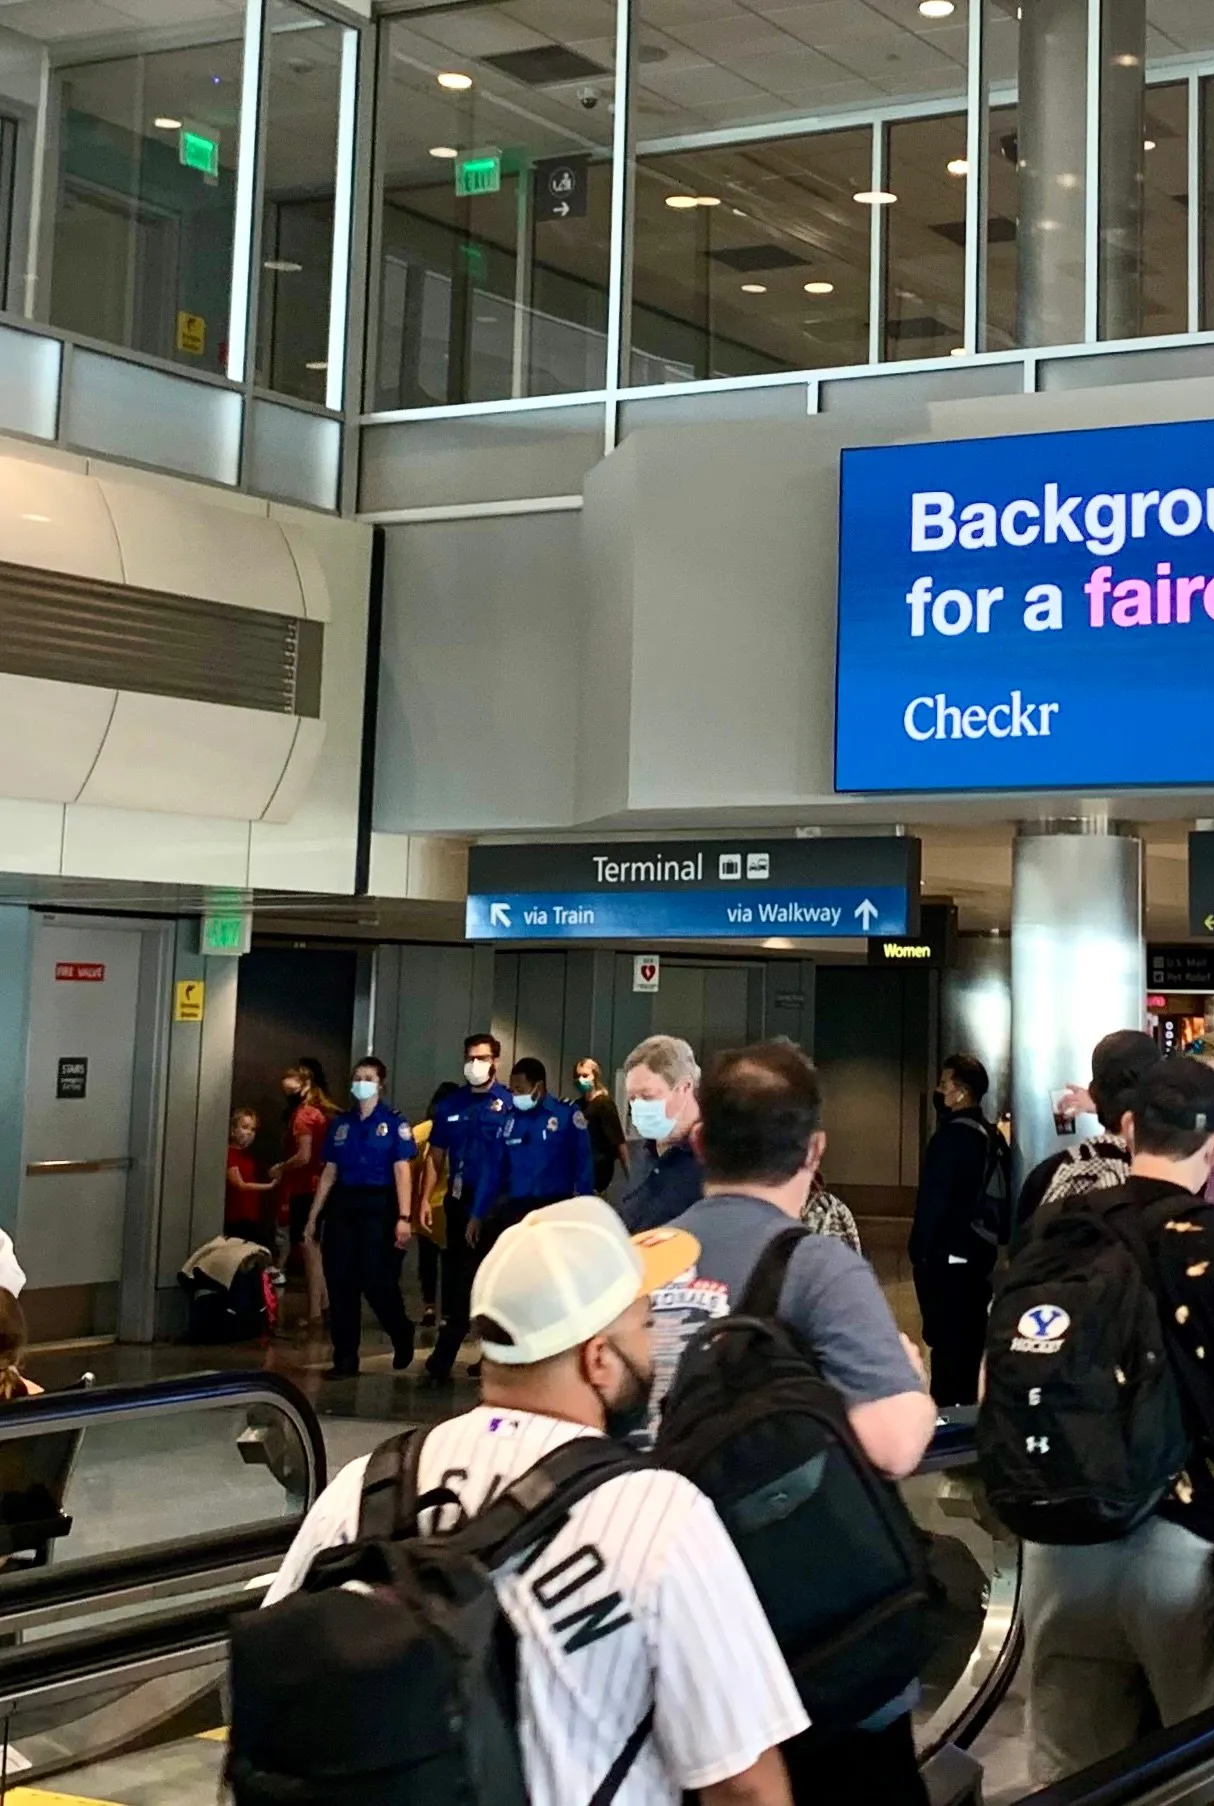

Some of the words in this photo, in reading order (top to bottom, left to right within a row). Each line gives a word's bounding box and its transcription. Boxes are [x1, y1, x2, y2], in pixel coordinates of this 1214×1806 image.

[905, 577, 1003, 636] for
[1023, 584, 1063, 630] a
[903, 690, 1060, 741] Checkr
[592, 852, 703, 883] Terminal
[523, 905, 548, 925] via
[552, 905, 595, 925] Train
[727, 903, 753, 923] via
[758, 902, 842, 927] Walkway
[883, 943, 931, 958] Women
